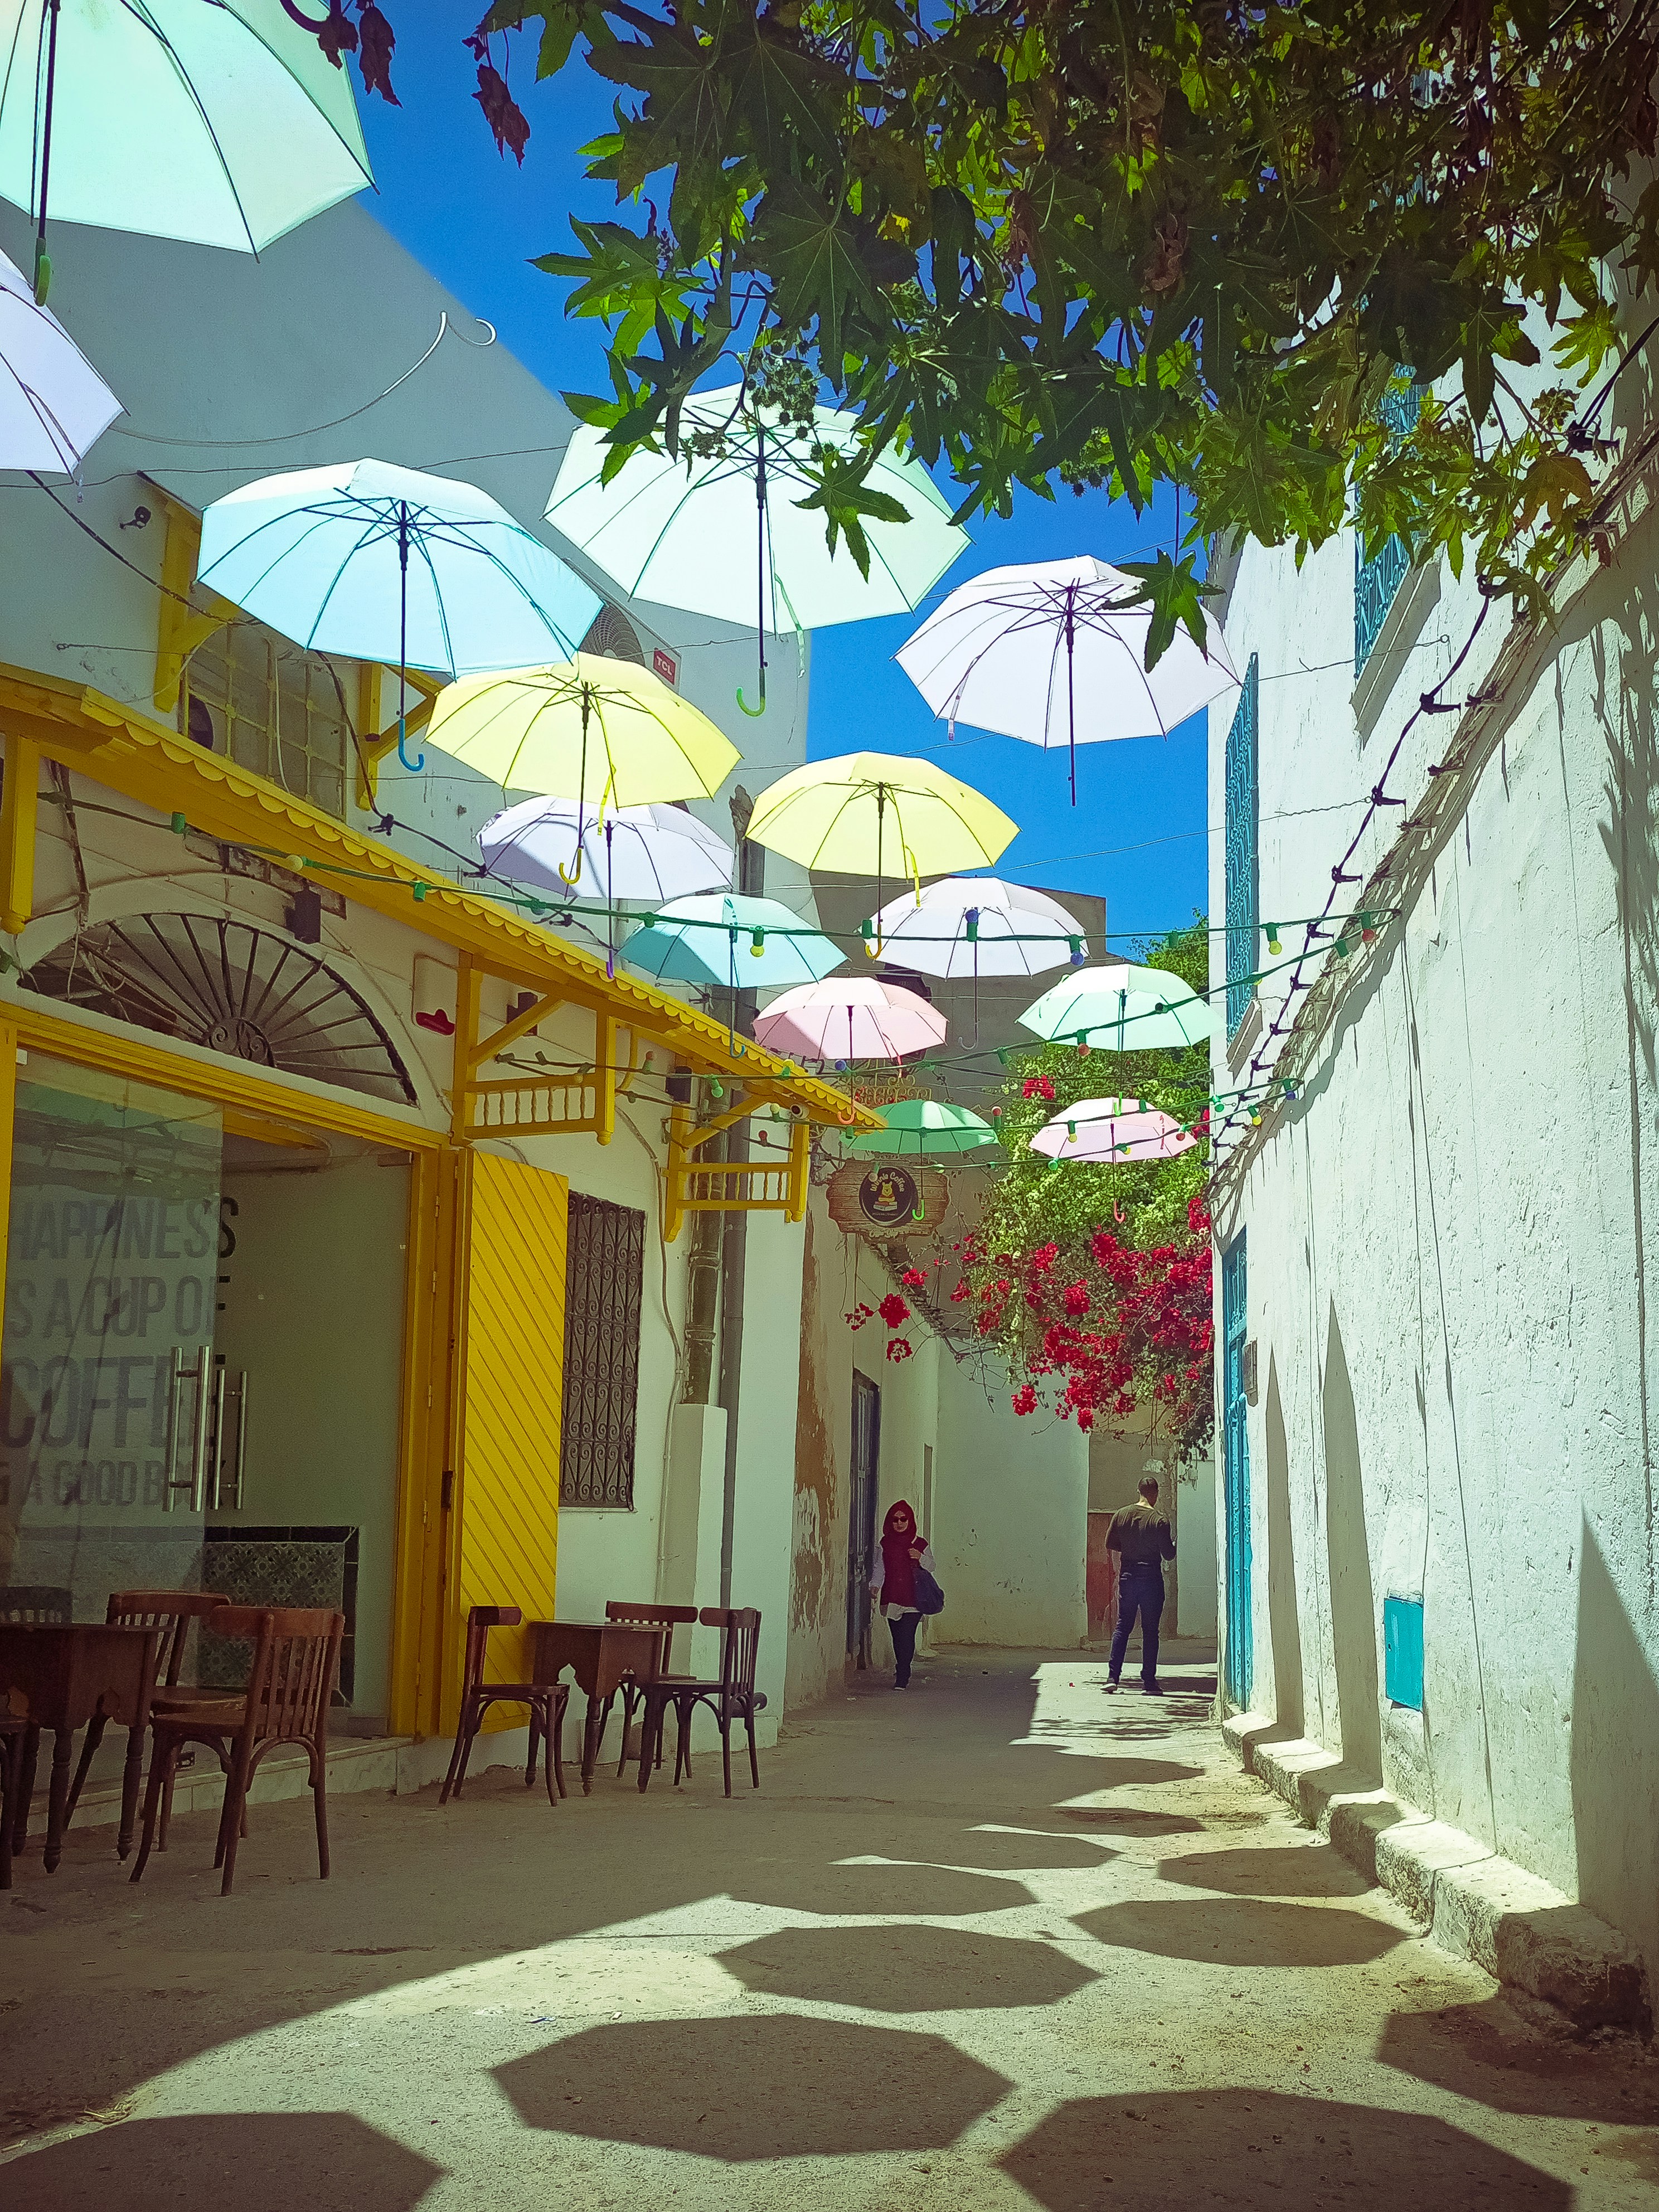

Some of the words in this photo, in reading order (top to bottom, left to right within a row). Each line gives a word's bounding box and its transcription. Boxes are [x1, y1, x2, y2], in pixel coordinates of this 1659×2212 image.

[656, 655, 673, 676] TCL
[890, 1171, 905, 1192] Coffee
[85, 1275, 167, 1338] CUP
